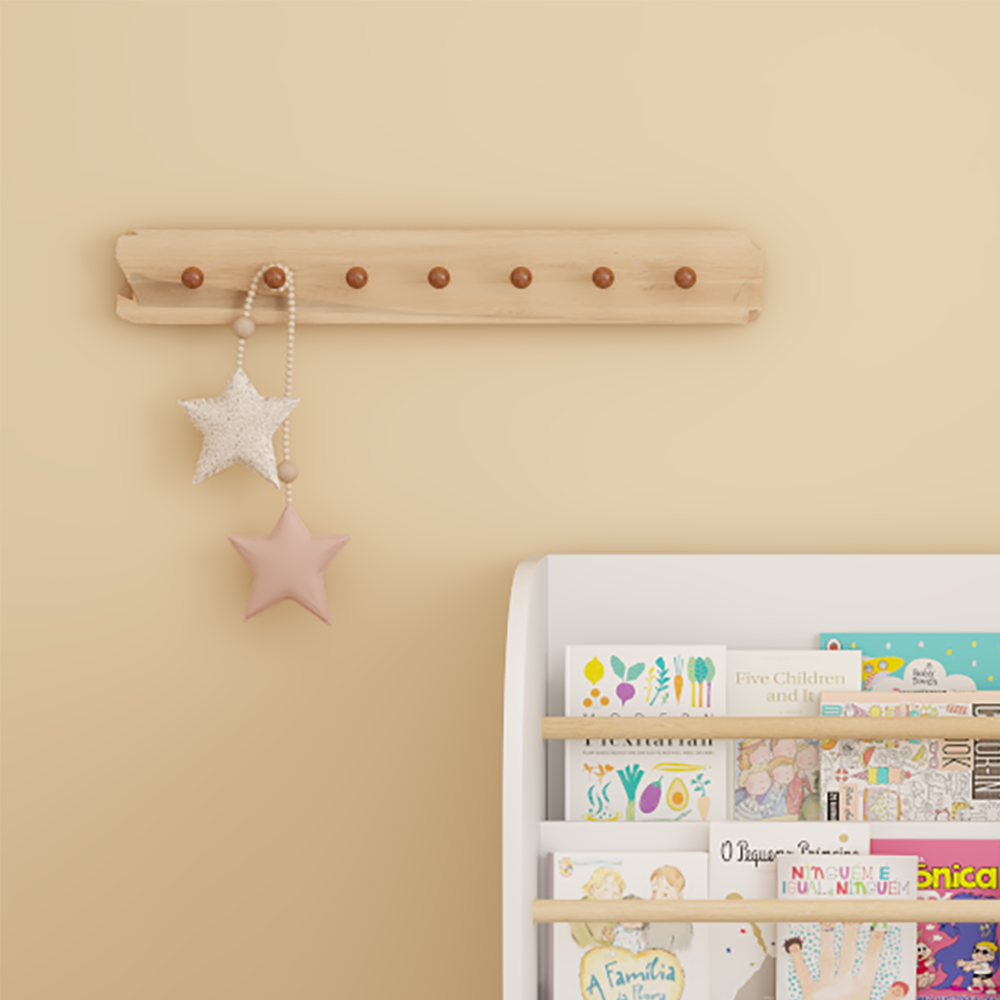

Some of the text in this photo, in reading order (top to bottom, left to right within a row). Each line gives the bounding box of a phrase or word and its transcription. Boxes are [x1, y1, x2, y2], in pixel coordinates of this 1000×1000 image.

[736, 671, 846, 686] Five Children
[766, 688, 798, 703] and
[720, 840, 733, 862] O
[604, 956, 676, 989] Família
